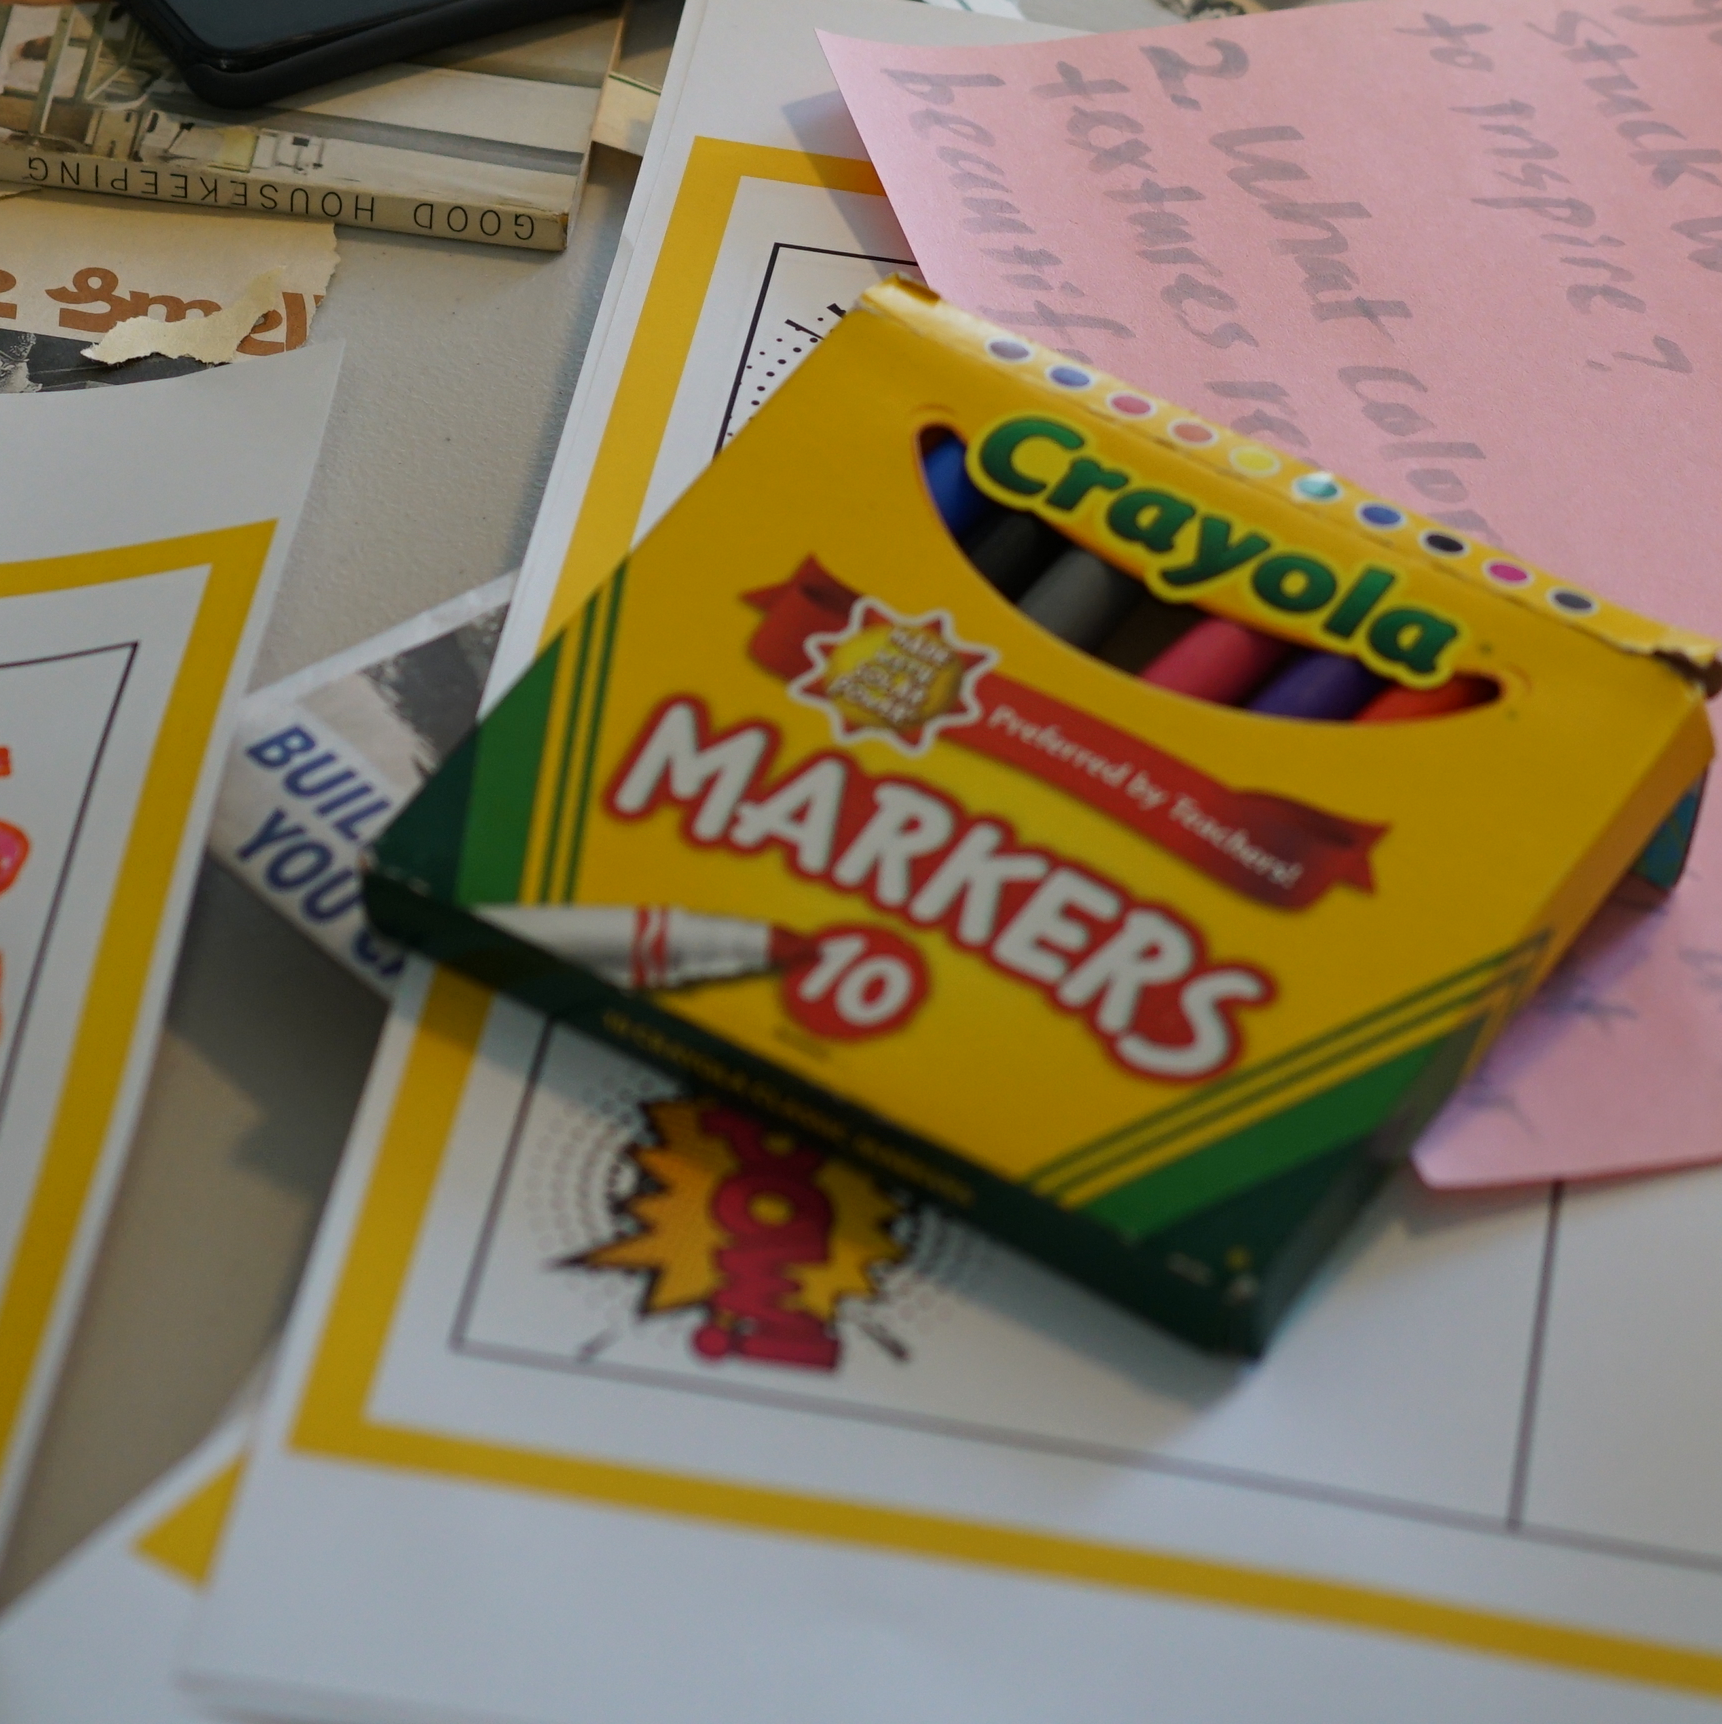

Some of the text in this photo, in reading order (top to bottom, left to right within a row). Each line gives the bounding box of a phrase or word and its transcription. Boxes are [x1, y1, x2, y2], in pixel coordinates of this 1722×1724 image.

[1394, 11, 1496, 76] to
[27, 155, 537, 243] GOOD HOUSEKEEPING
[1208, 123, 1415, 346] What
[44, 266, 325, 357] Smel
[977, 418, 1459, 679] Crayola
[243, 724, 392, 843] BUIL
[988, 703, 1306, 890] Preferred by Teachers!
[612, 701, 1261, 1078] MARKERS
[790, 931, 912, 1028] 10
